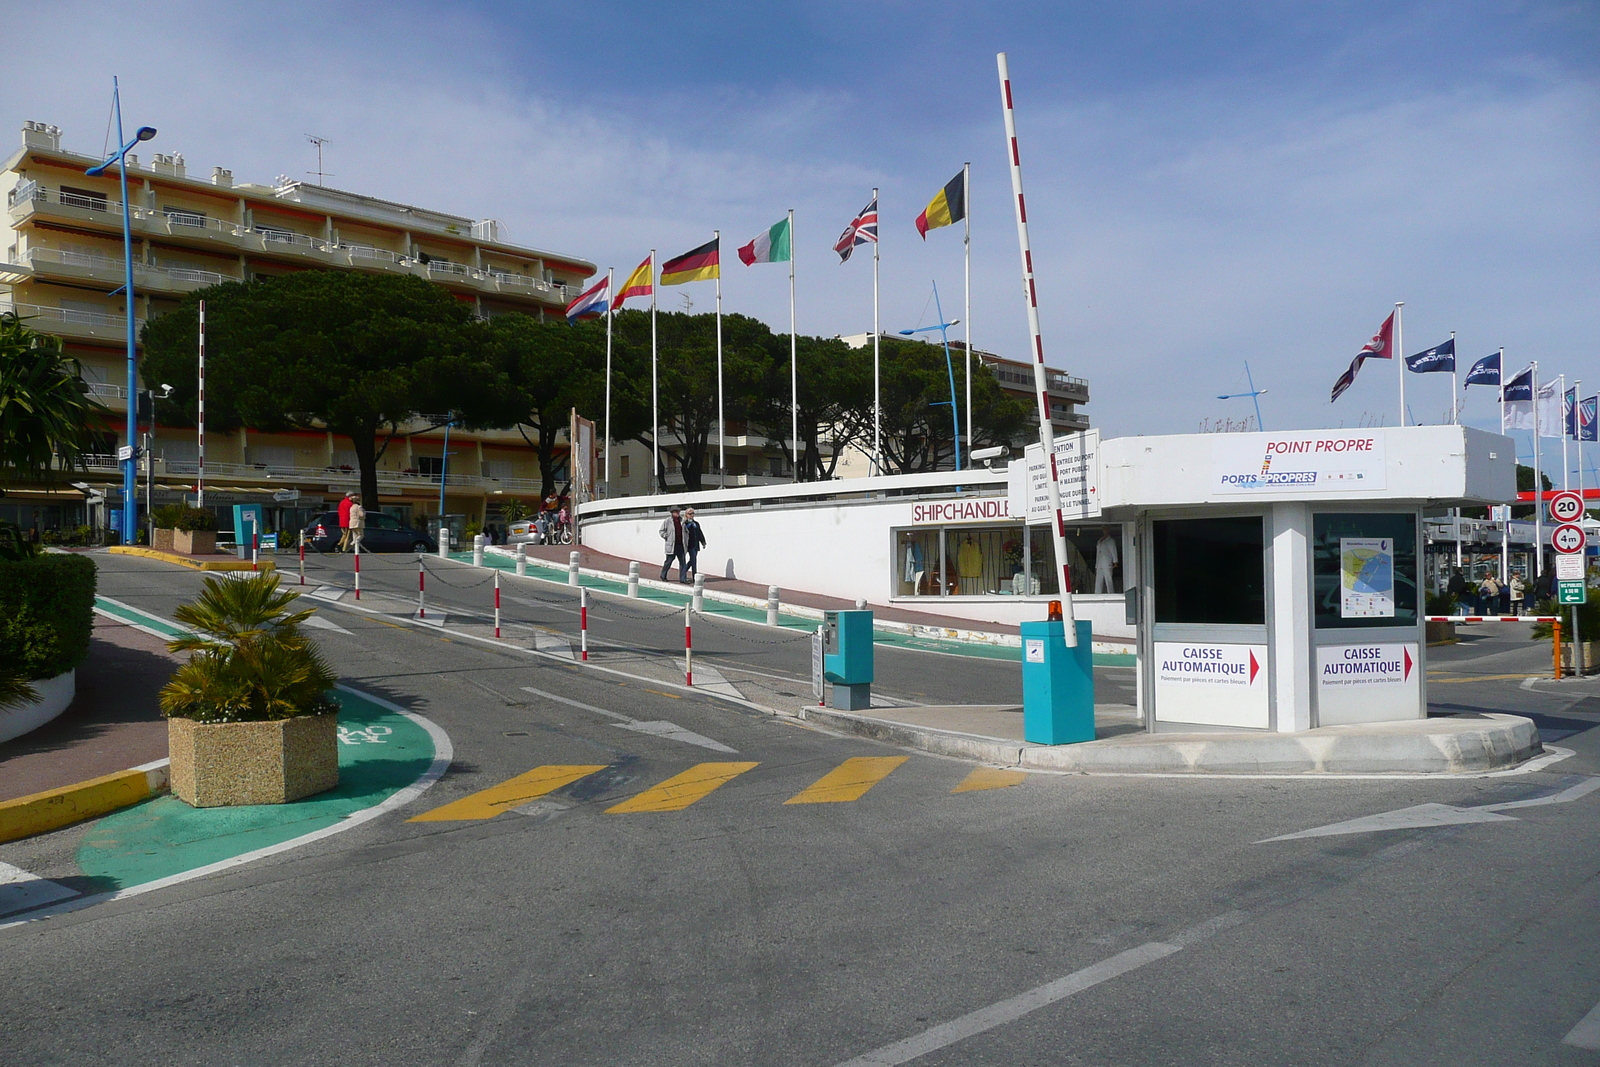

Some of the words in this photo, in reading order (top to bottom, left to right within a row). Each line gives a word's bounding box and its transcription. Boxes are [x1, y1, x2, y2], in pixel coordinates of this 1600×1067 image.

[1054, 442, 1074, 453] ENTION
[1266, 441, 1312, 454] POINT
[1314, 438, 1374, 453] PROPRE
[1081, 453, 1094, 461] PORT
[1060, 467, 1071, 476] PORT
[1221, 474, 1258, 484] PORTS
[1266, 472, 1315, 483] PROPRES
[914, 500, 1008, 521] SHIPCHANDLE
[1558, 501, 1576, 512] 20
[1560, 534, 1568, 543] 4
[1183, 648, 1223, 660] CAISSE
[1344, 648, 1381, 660] CAISSE
[1162, 661, 1246, 675] AUTOMATIQUE
[1323, 661, 1401, 675] AUTOMATIQUE
